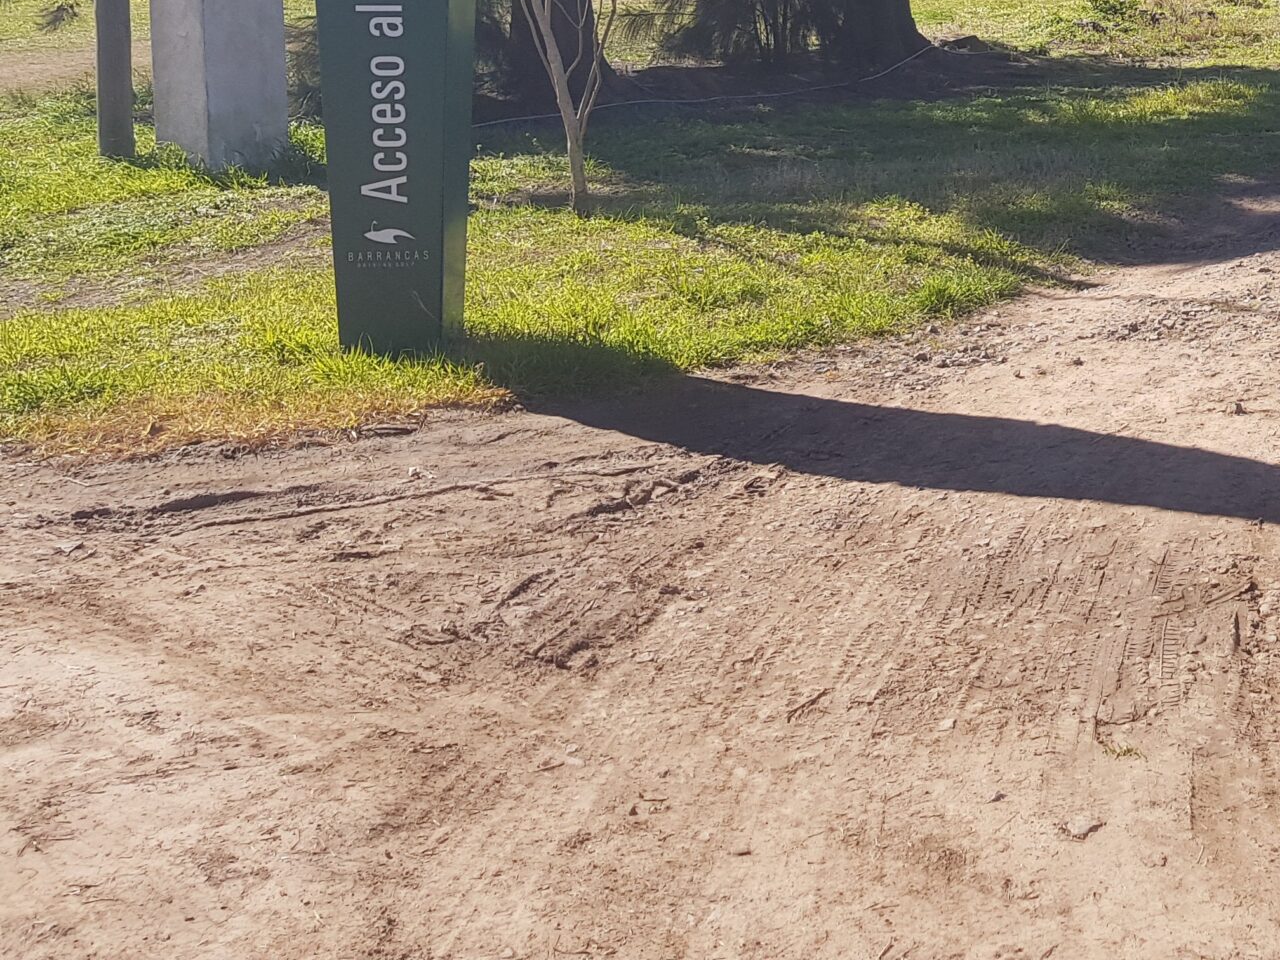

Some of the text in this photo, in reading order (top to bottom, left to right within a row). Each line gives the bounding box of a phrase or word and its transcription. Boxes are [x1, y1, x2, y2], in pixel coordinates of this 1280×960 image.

[355, 4, 404, 37] al
[360, 55, 408, 203] Acceso
[348, 250, 429, 262] BARRANCAS
